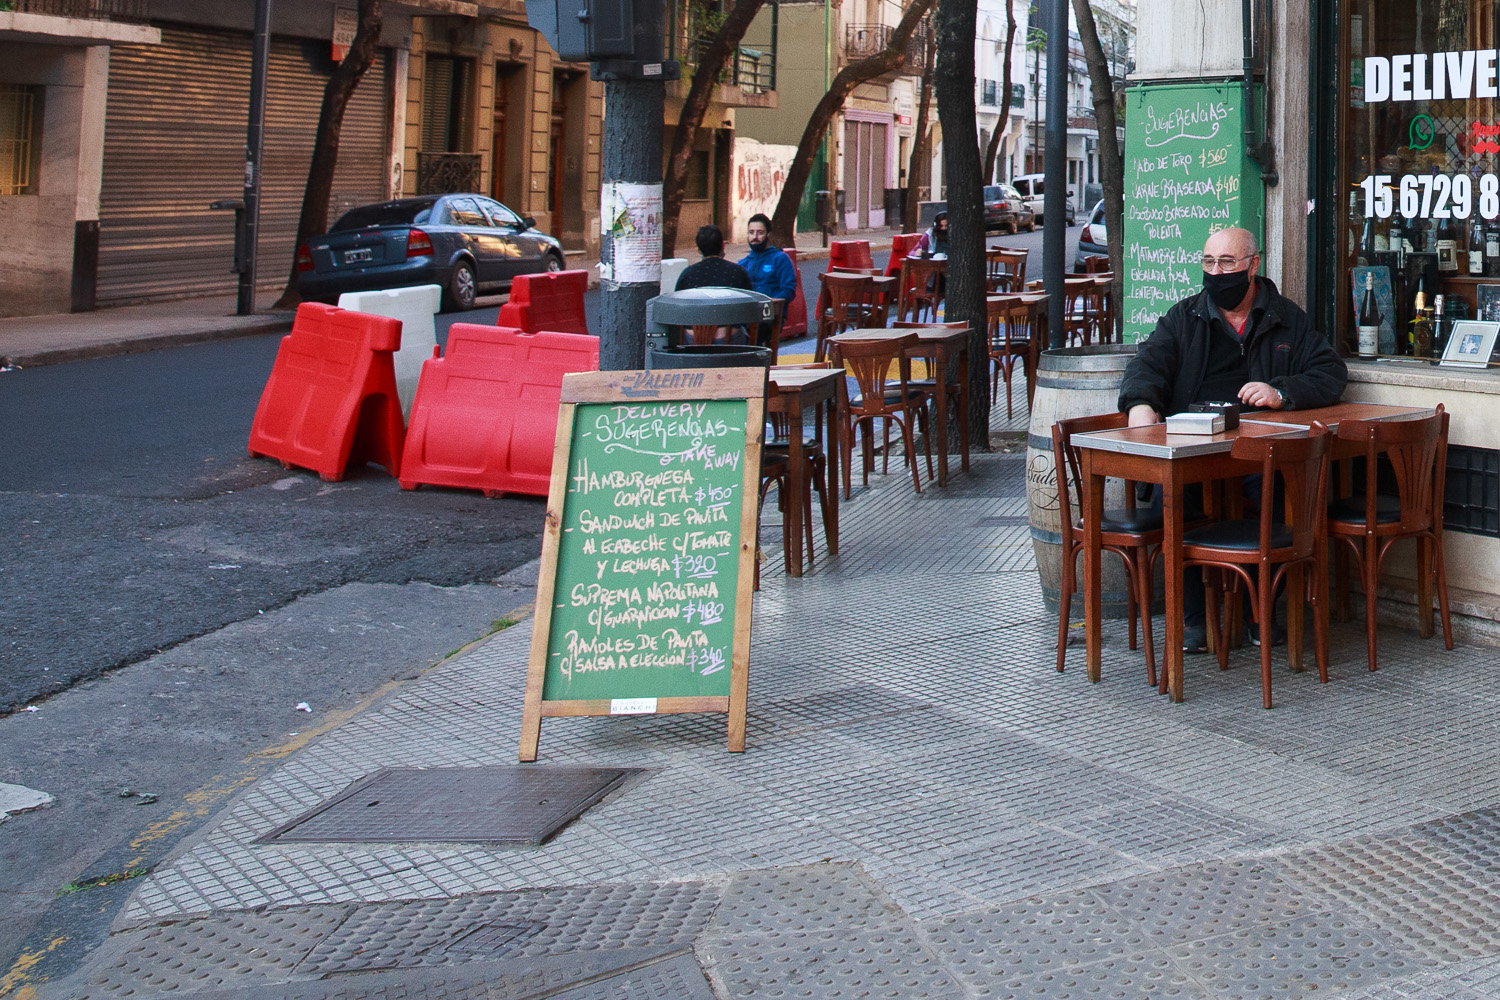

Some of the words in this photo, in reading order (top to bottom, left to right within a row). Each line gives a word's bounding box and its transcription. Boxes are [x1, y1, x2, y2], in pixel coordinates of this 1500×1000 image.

[1472, 122, 1500, 138] Rappi
[1155, 158, 1168, 170] DE
[1170, 153, 1191, 174] TORO
[1361, 175, 1393, 219] 15
[1400, 174, 1471, 219] 6729
[1212, 204, 1229, 219] CON
[1145, 223, 1181, 240] POLENTA
[1131, 243, 1176, 267] MATAMBRE
[1169, 266, 1190, 287] RUSA
[611, 403, 706, 424] DELIVERY
[680, 445, 717, 463] TAKE
[705, 450, 740, 470] AWAY
[614, 487, 692, 506] COMPLETA
[580, 510, 654, 533] SANDWICH
[660, 512, 680, 526] DE
[686, 507, 727, 525] PAVITA
[583, 536, 598, 554] AL
[598, 561, 608, 578] Y
[614, 558, 670, 578] LECHUGA
[572, 583, 642, 608] SUPREMA
[647, 582, 718, 603] NAPOLITANA
[565, 630, 634, 657] RAVIOLES
[636, 634, 657, 650] DE
[662, 629, 708, 648] PAVITA
[619, 656, 627, 668] A
